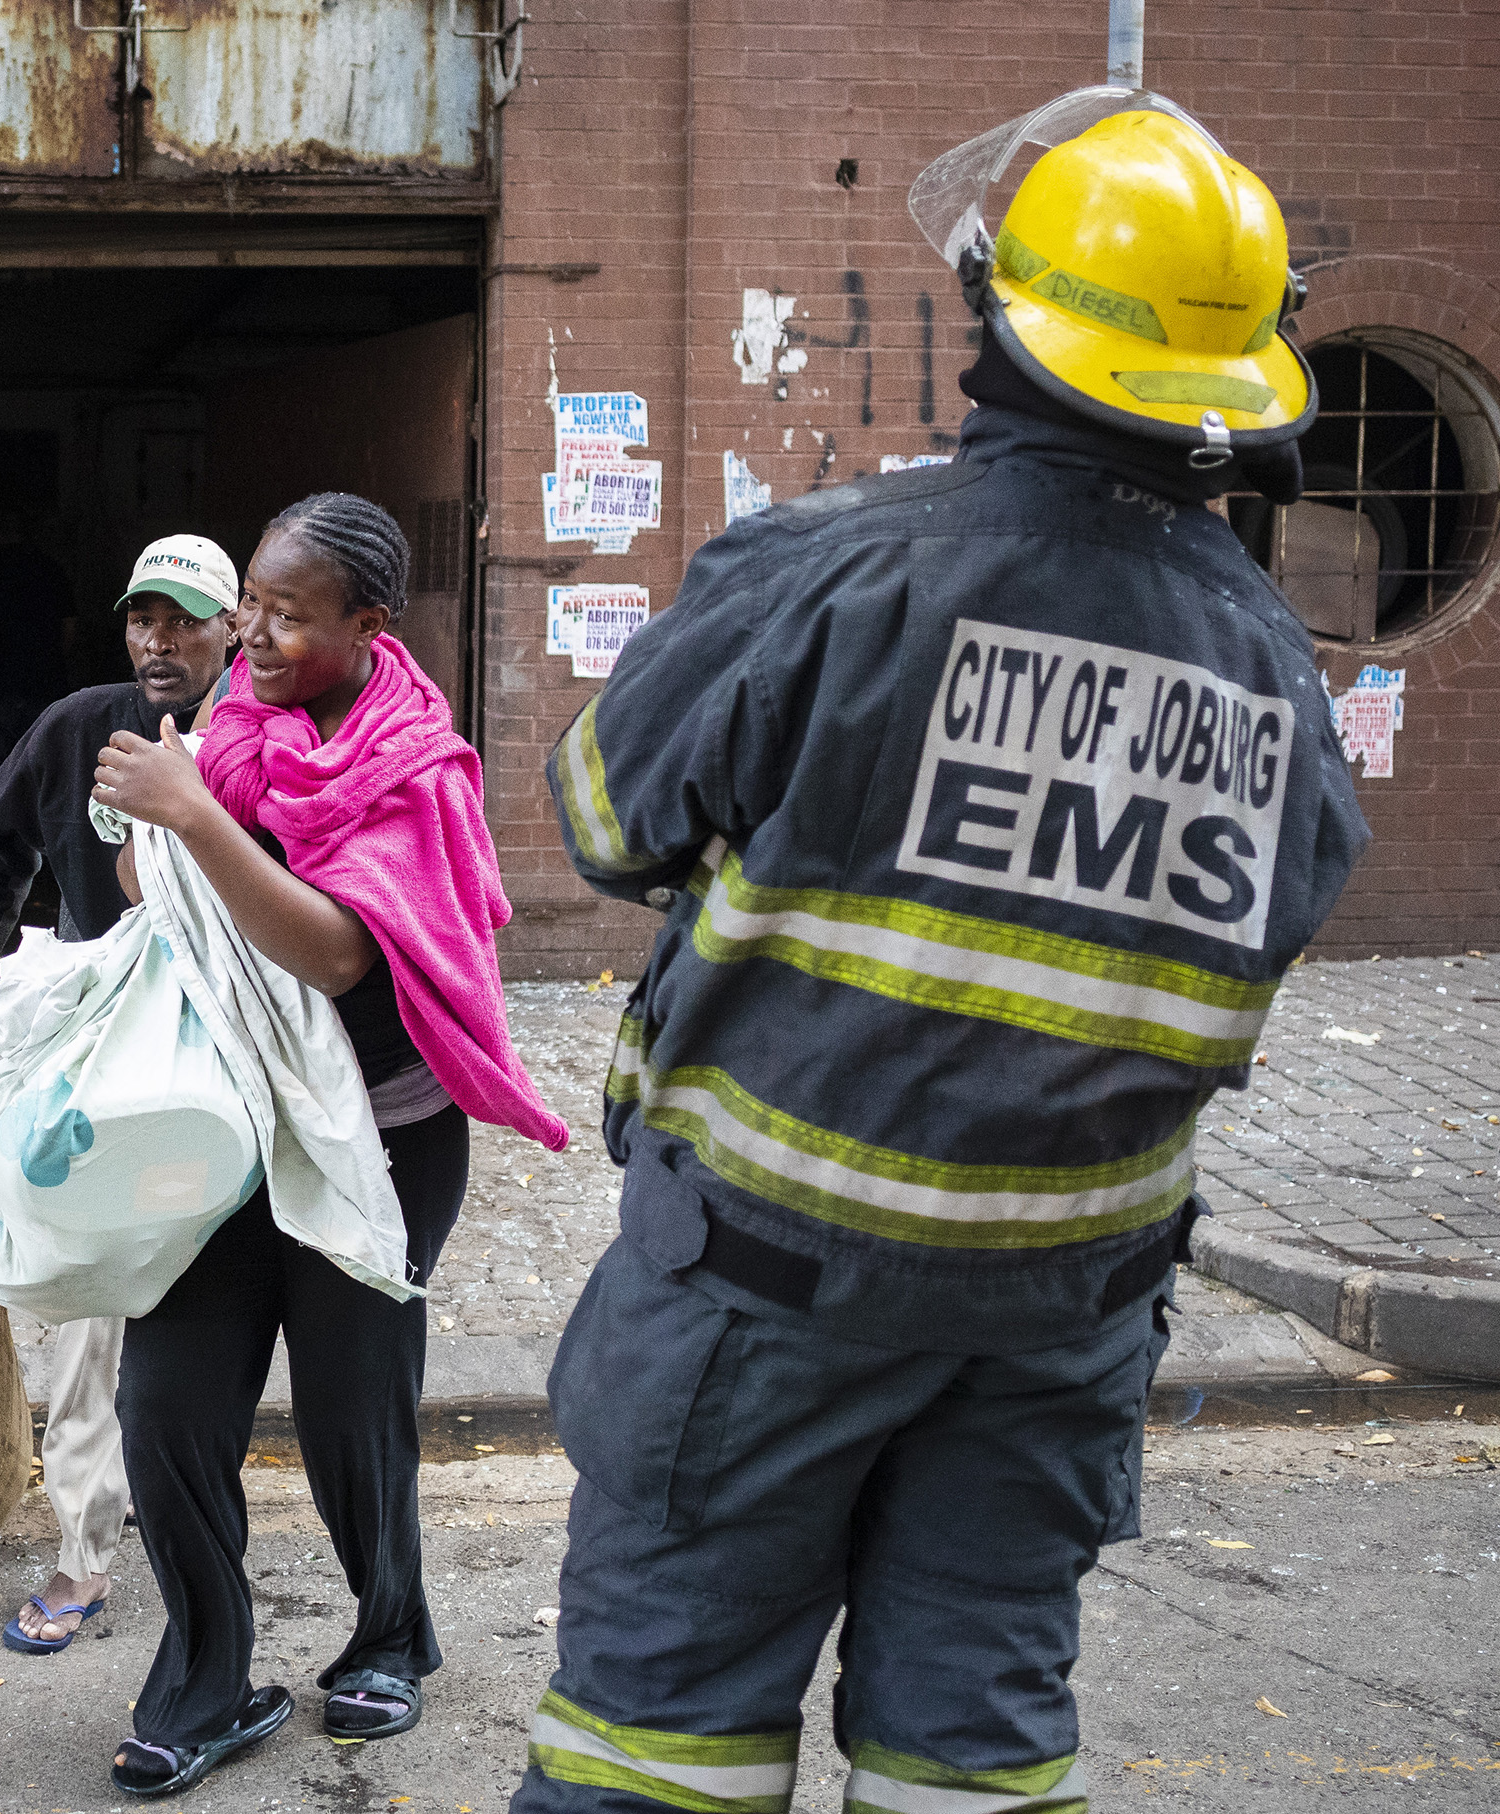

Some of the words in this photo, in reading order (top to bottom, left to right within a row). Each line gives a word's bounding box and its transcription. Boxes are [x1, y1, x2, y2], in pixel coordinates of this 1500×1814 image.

[574, 411, 631, 425] NGWENYA
[561, 442, 618, 452] PROPHET
[593, 474, 651, 490] ABORTION
[628, 503, 649, 518] 1333
[143, 555, 201, 573] HUTTIG
[587, 610, 644, 624] ABORTION
[944, 640, 1062, 752] CITY
[1061, 659, 1128, 763] OF
[1129, 675, 1282, 809] JOBURG
[916, 758, 1258, 924] EMS
